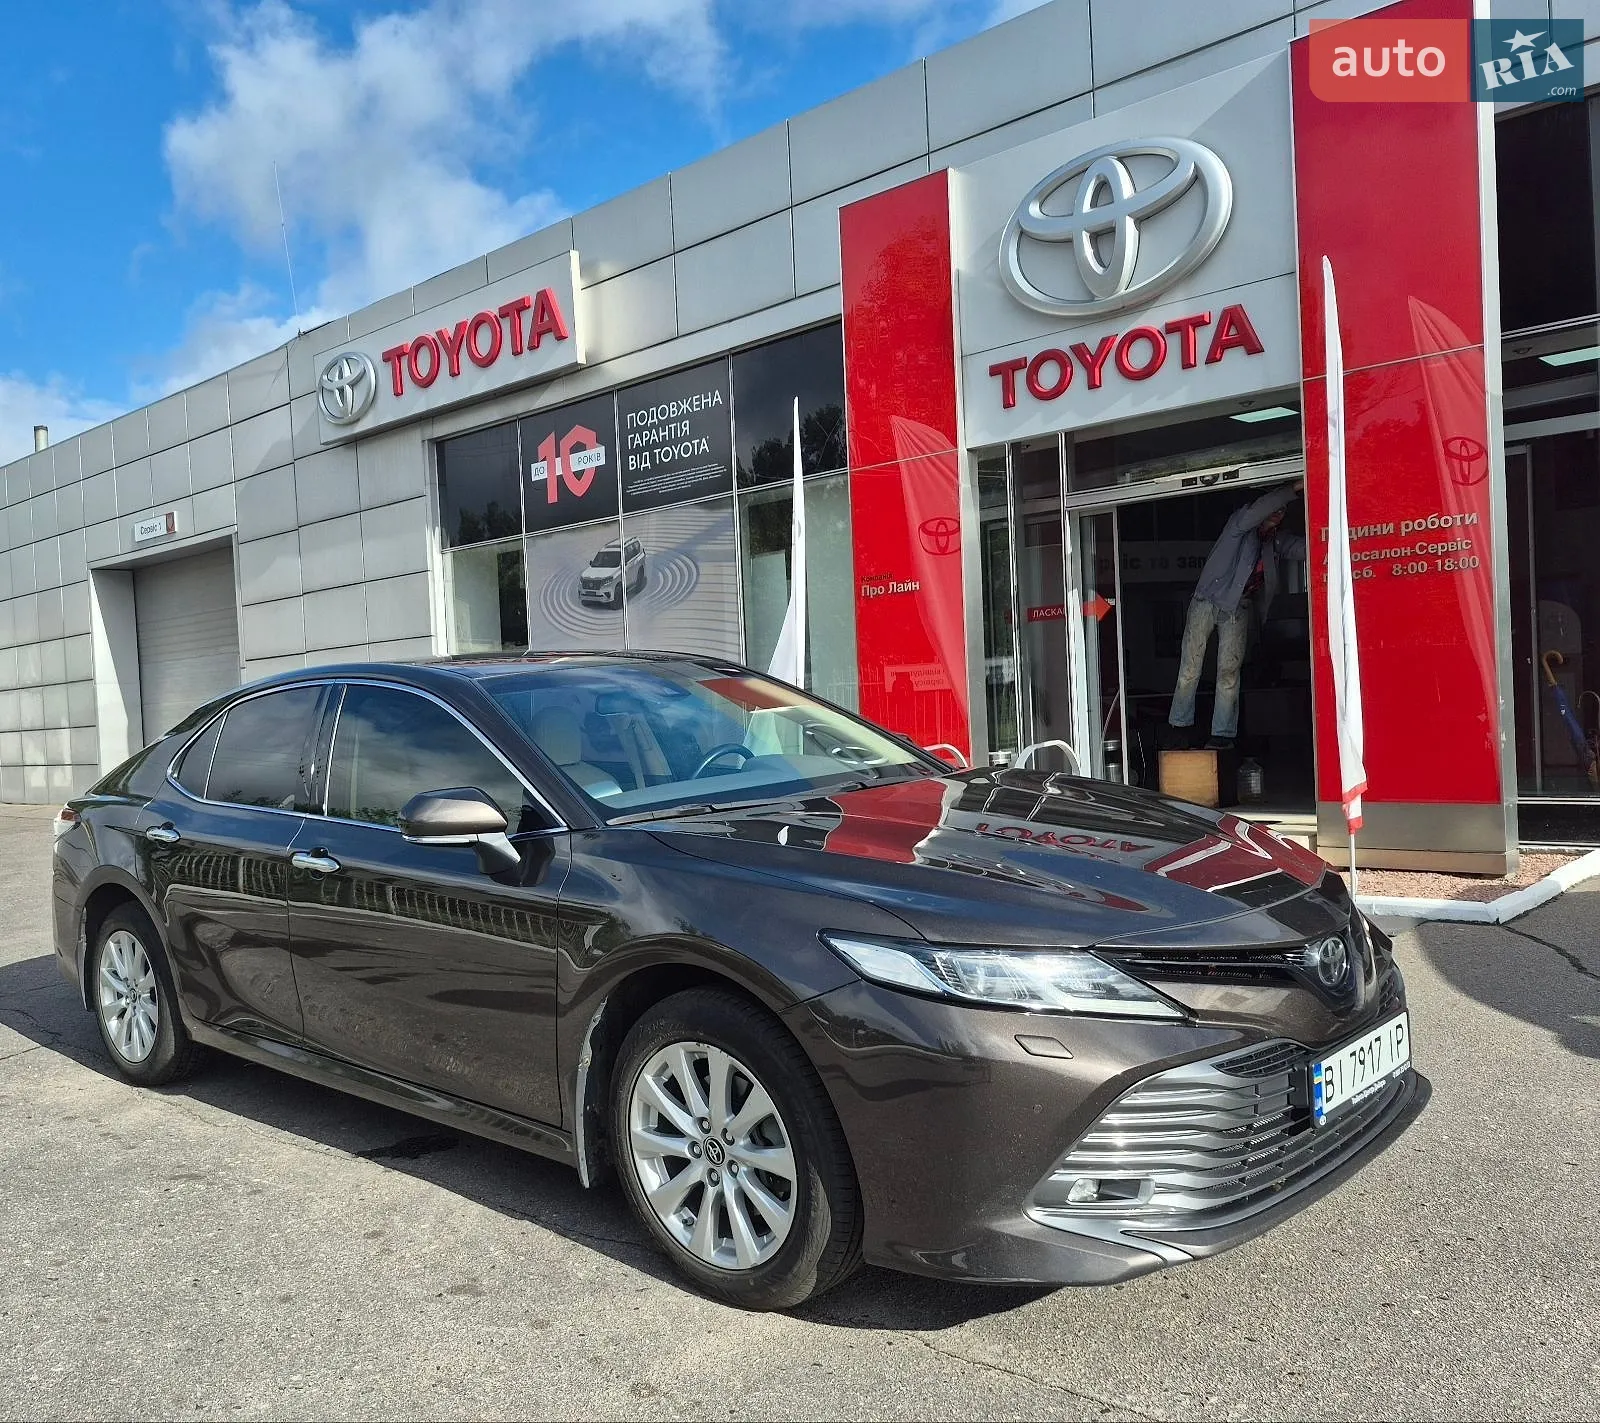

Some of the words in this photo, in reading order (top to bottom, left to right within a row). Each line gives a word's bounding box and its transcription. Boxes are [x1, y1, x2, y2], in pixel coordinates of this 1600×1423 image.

[382, 287, 568, 396] TOYOTA
[989, 304, 1265, 409] TOYOTA
[627, 389, 722, 429] ПОДОВЖЕНА
[628, 420, 690, 449] ГАРАНТІЯ
[534, 466, 545, 477] ДО
[537, 424, 598, 504] 10
[577, 452, 602, 465] РОКІВ
[629, 451, 651, 471] ВІД
[1321, 522, 1394, 542] Гдини
[1400, 513, 1478, 536] роботи
[861, 584, 885, 598] Про
[888, 579, 920, 594] Лайн
[1033, 607, 1065, 618] ЛАСКА
[1325, 1059, 1343, 1104] BI
[1350, 1036, 1382, 1088] 7917
[1389, 1023, 1404, 1063] IP
